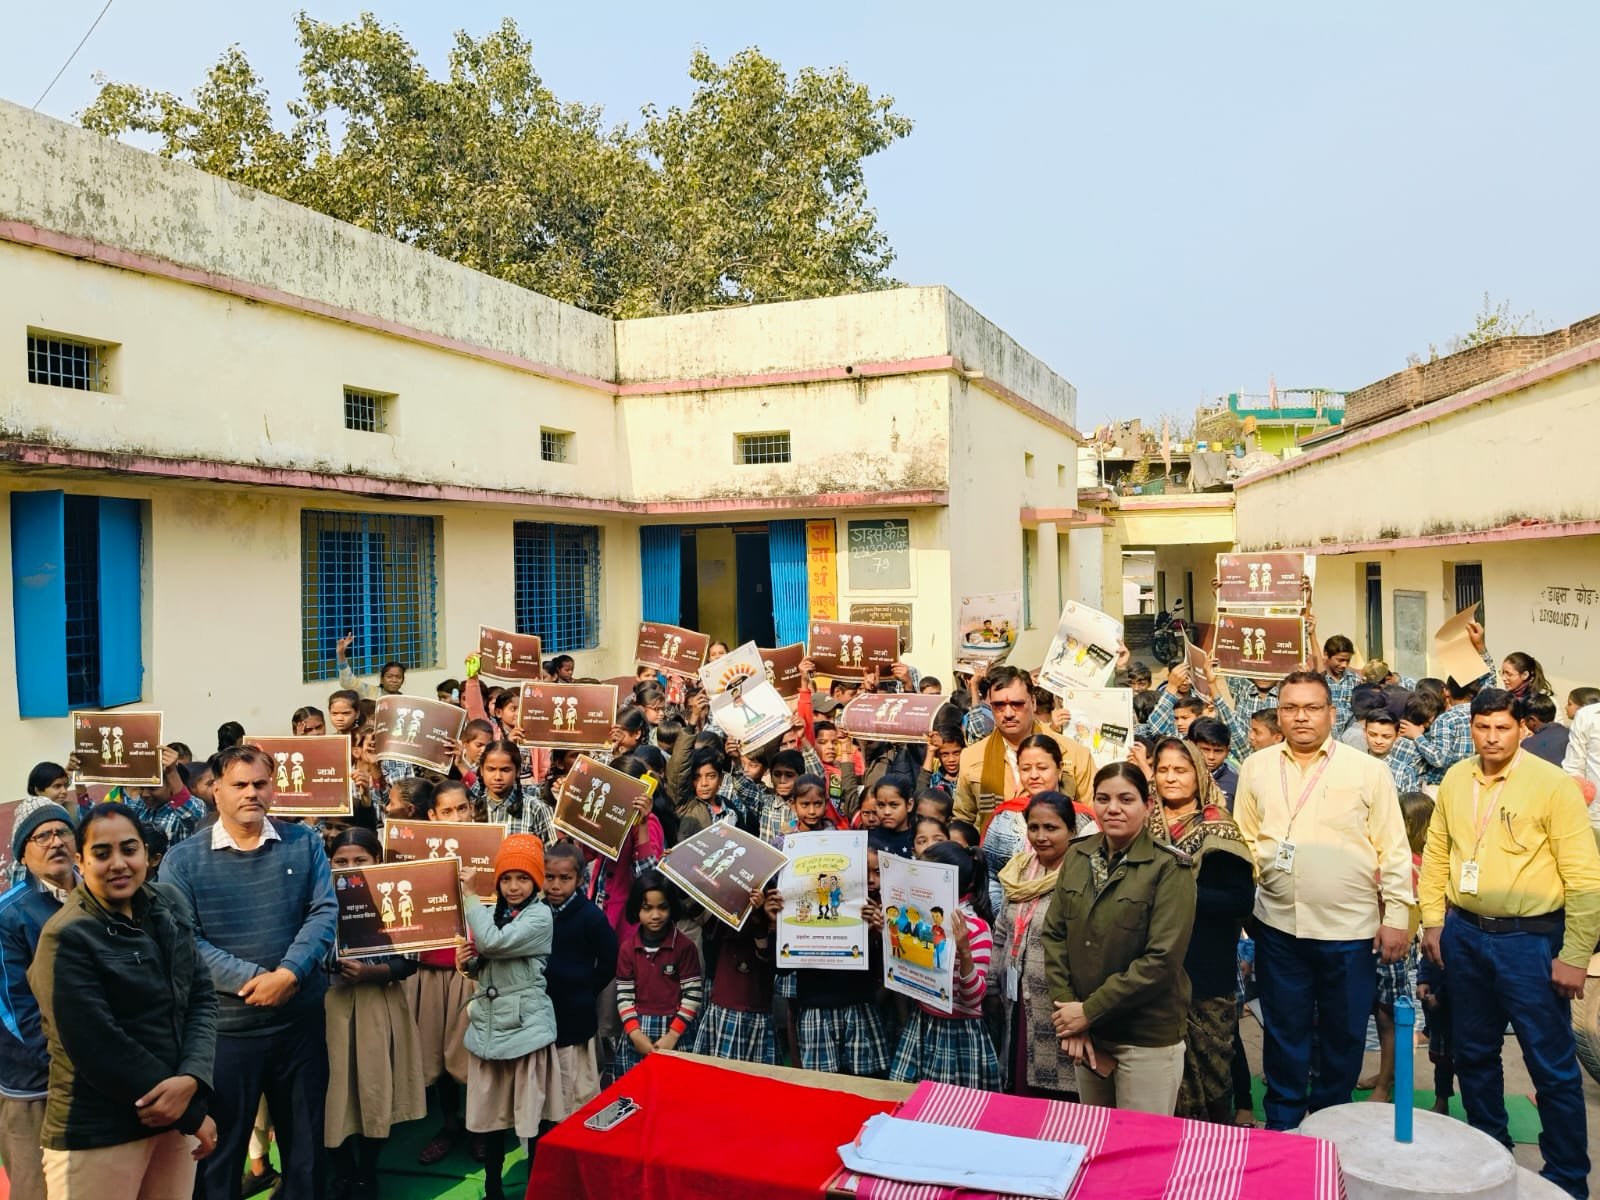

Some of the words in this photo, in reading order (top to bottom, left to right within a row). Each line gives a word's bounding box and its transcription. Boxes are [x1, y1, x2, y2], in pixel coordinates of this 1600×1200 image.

[849, 528, 883, 544] डाइस
[1574, 583, 1596, 605] कोड
[471, 856, 489, 865] जाओ
[427, 894, 448, 905] जाओ
